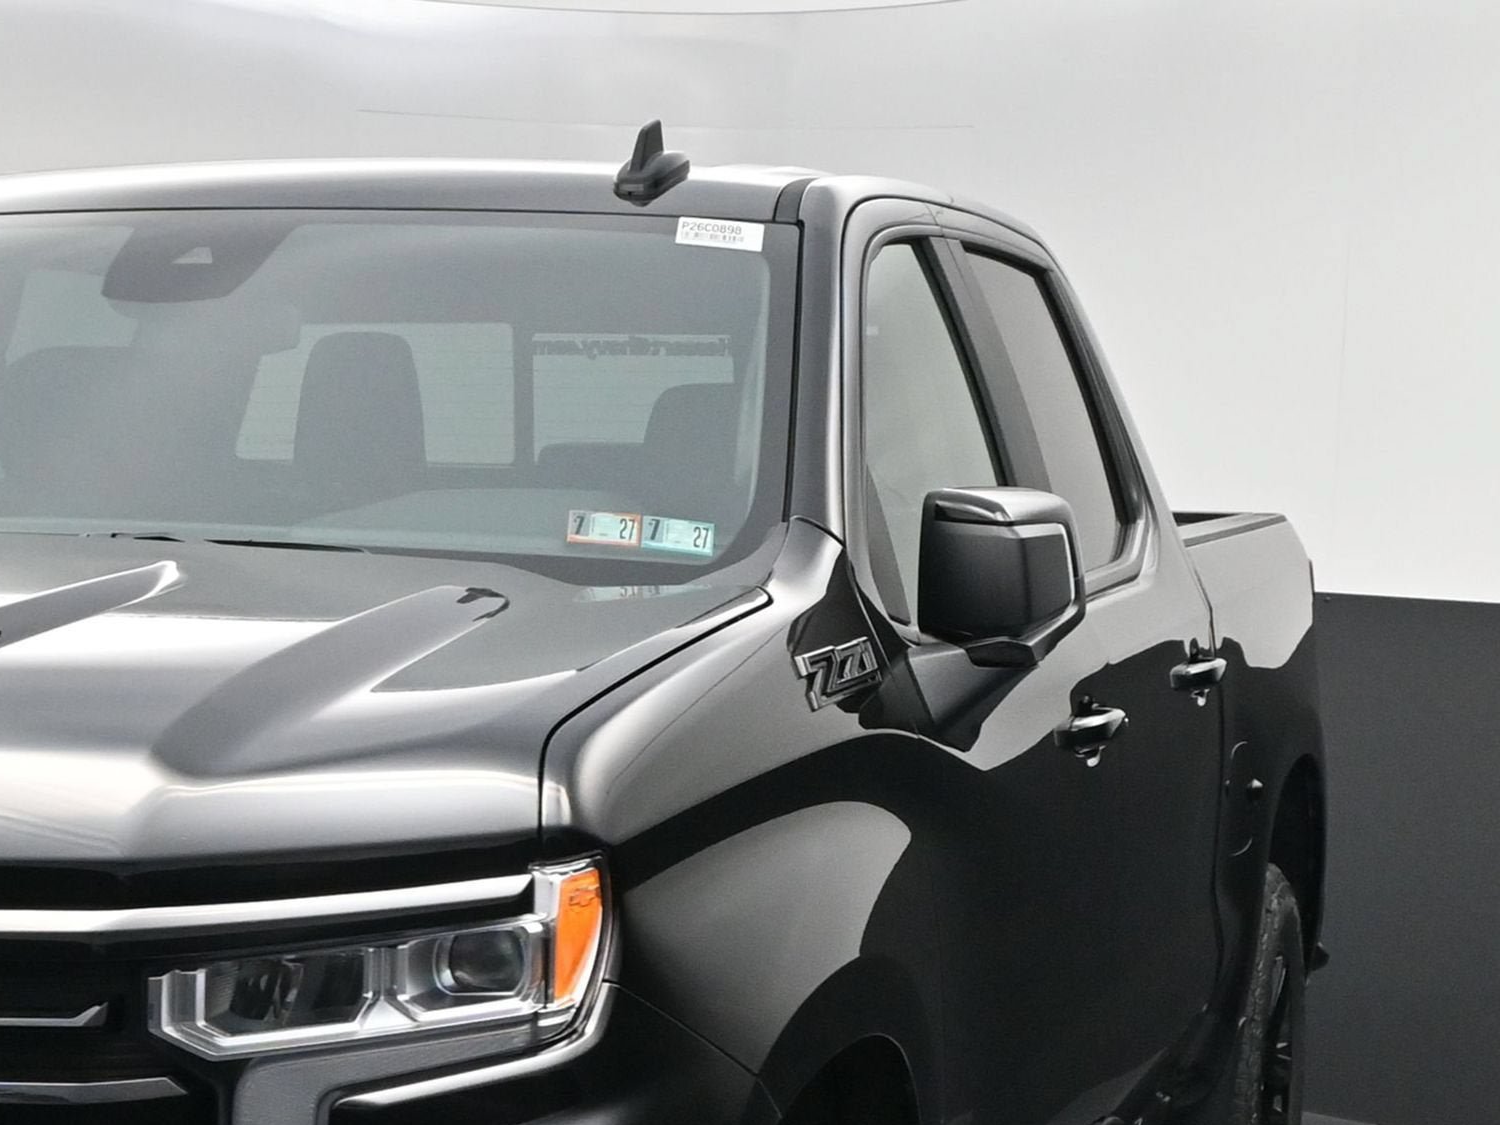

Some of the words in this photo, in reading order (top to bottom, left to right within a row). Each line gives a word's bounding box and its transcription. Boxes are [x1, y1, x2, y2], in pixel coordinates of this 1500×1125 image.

[619, 518, 635, 541] 27
[693, 526, 709, 549] 27
[794, 637, 881, 711] Z71
